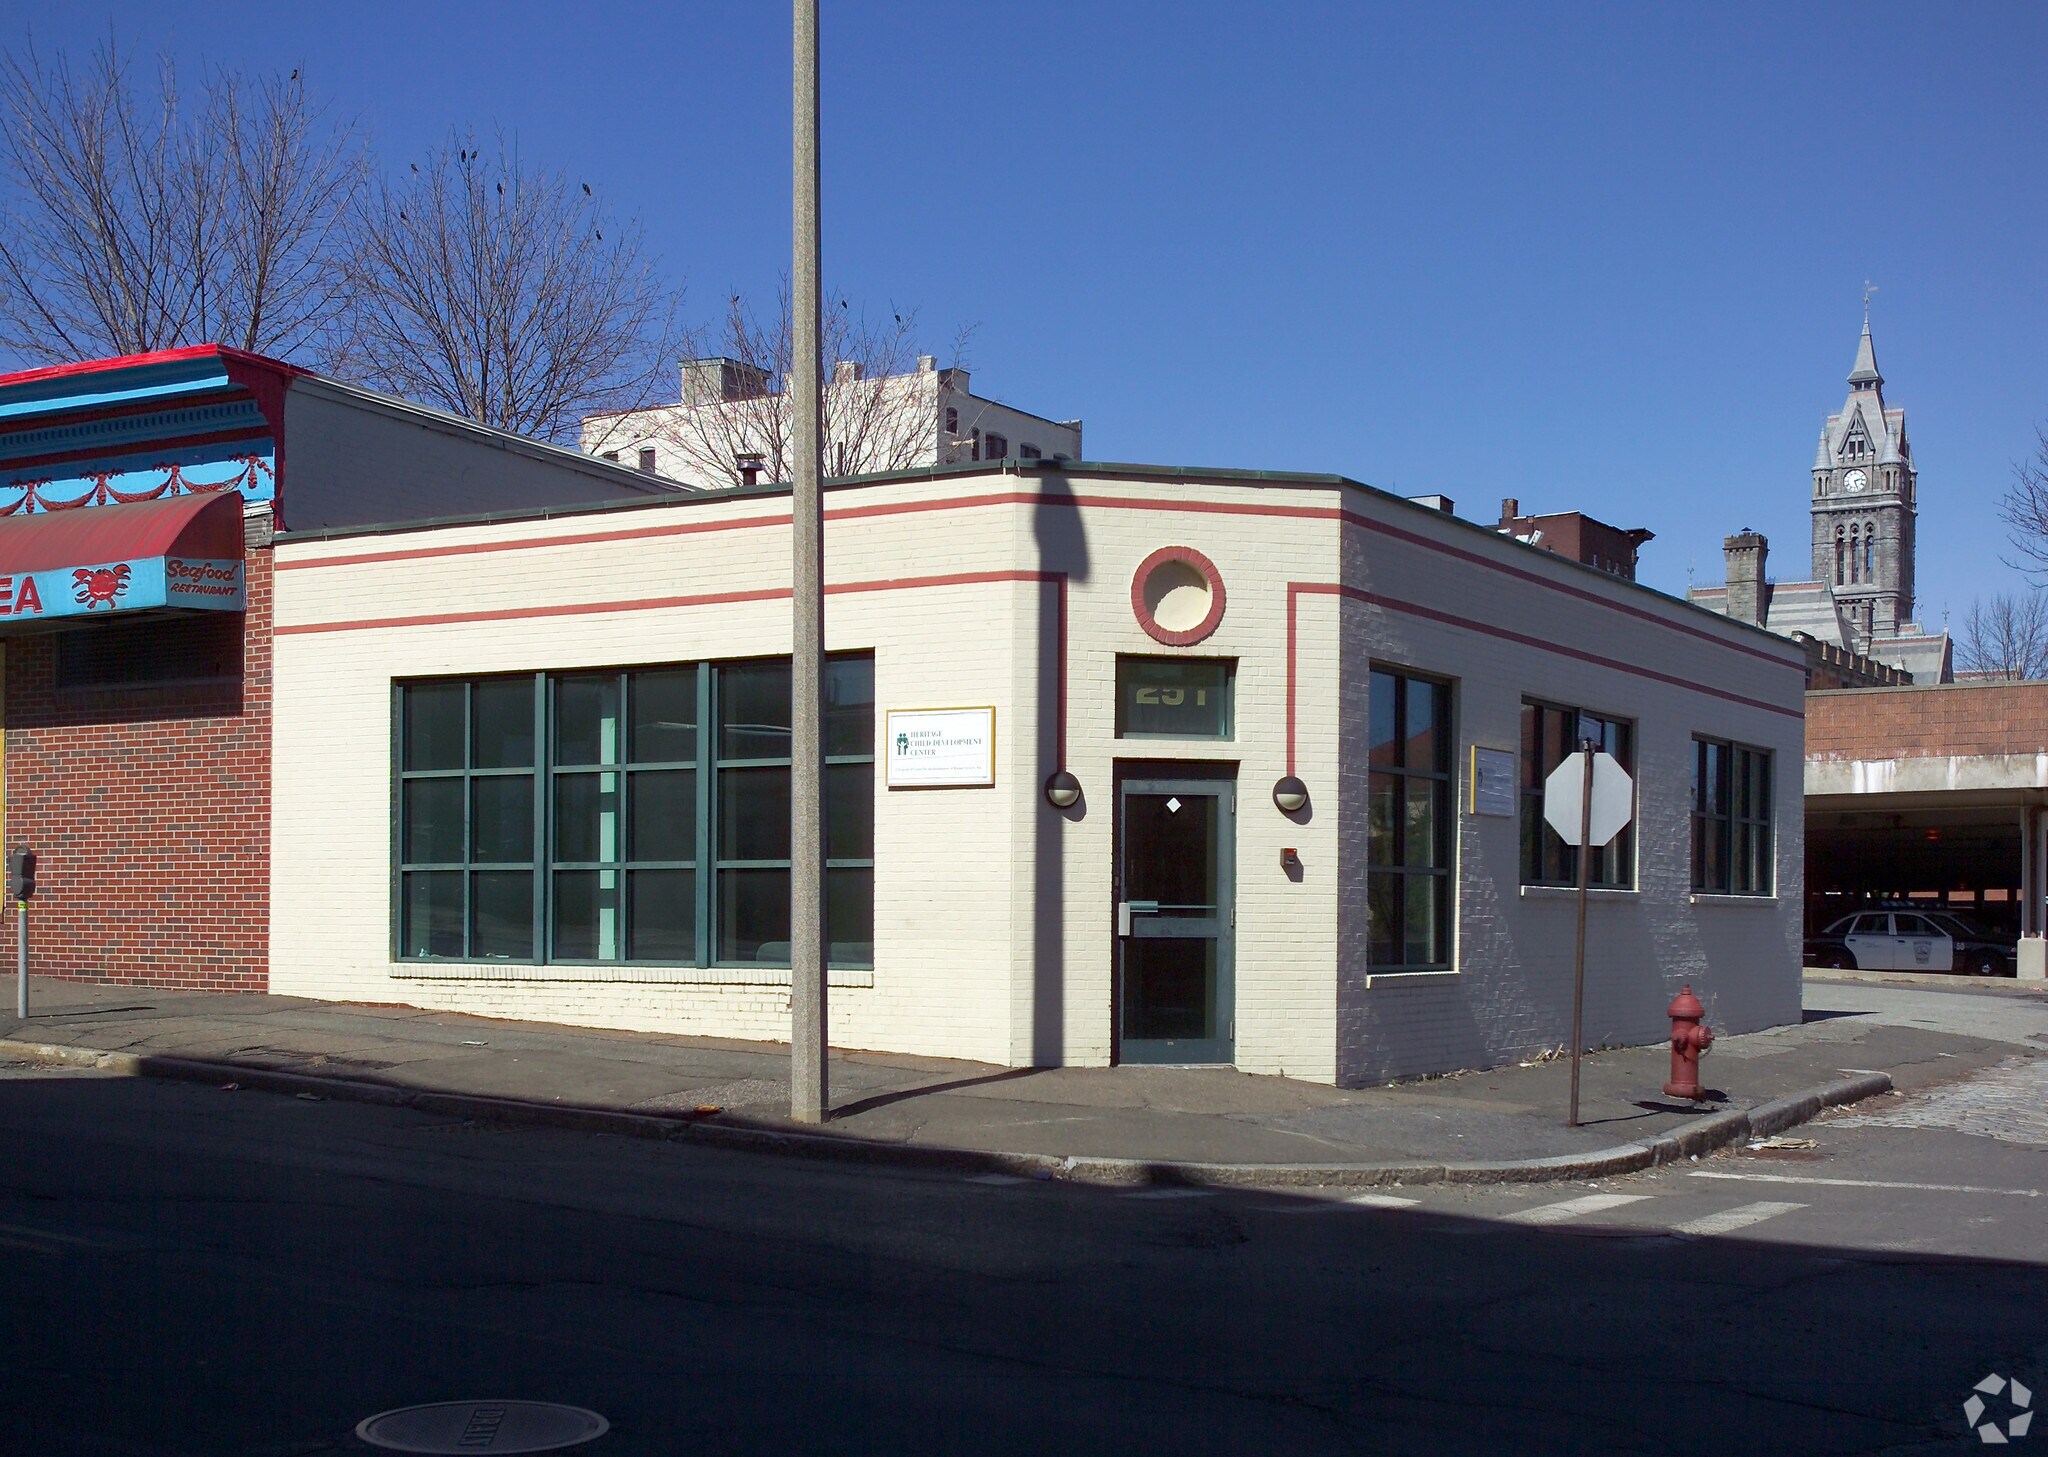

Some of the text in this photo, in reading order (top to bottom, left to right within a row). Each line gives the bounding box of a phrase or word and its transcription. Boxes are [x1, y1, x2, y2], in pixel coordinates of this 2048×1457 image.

[166, 559, 239, 583] Seafood
[170, 583, 238, 597] RESTAURANT
[910, 738, 982, 747] CHILD DEVELOPMENT
